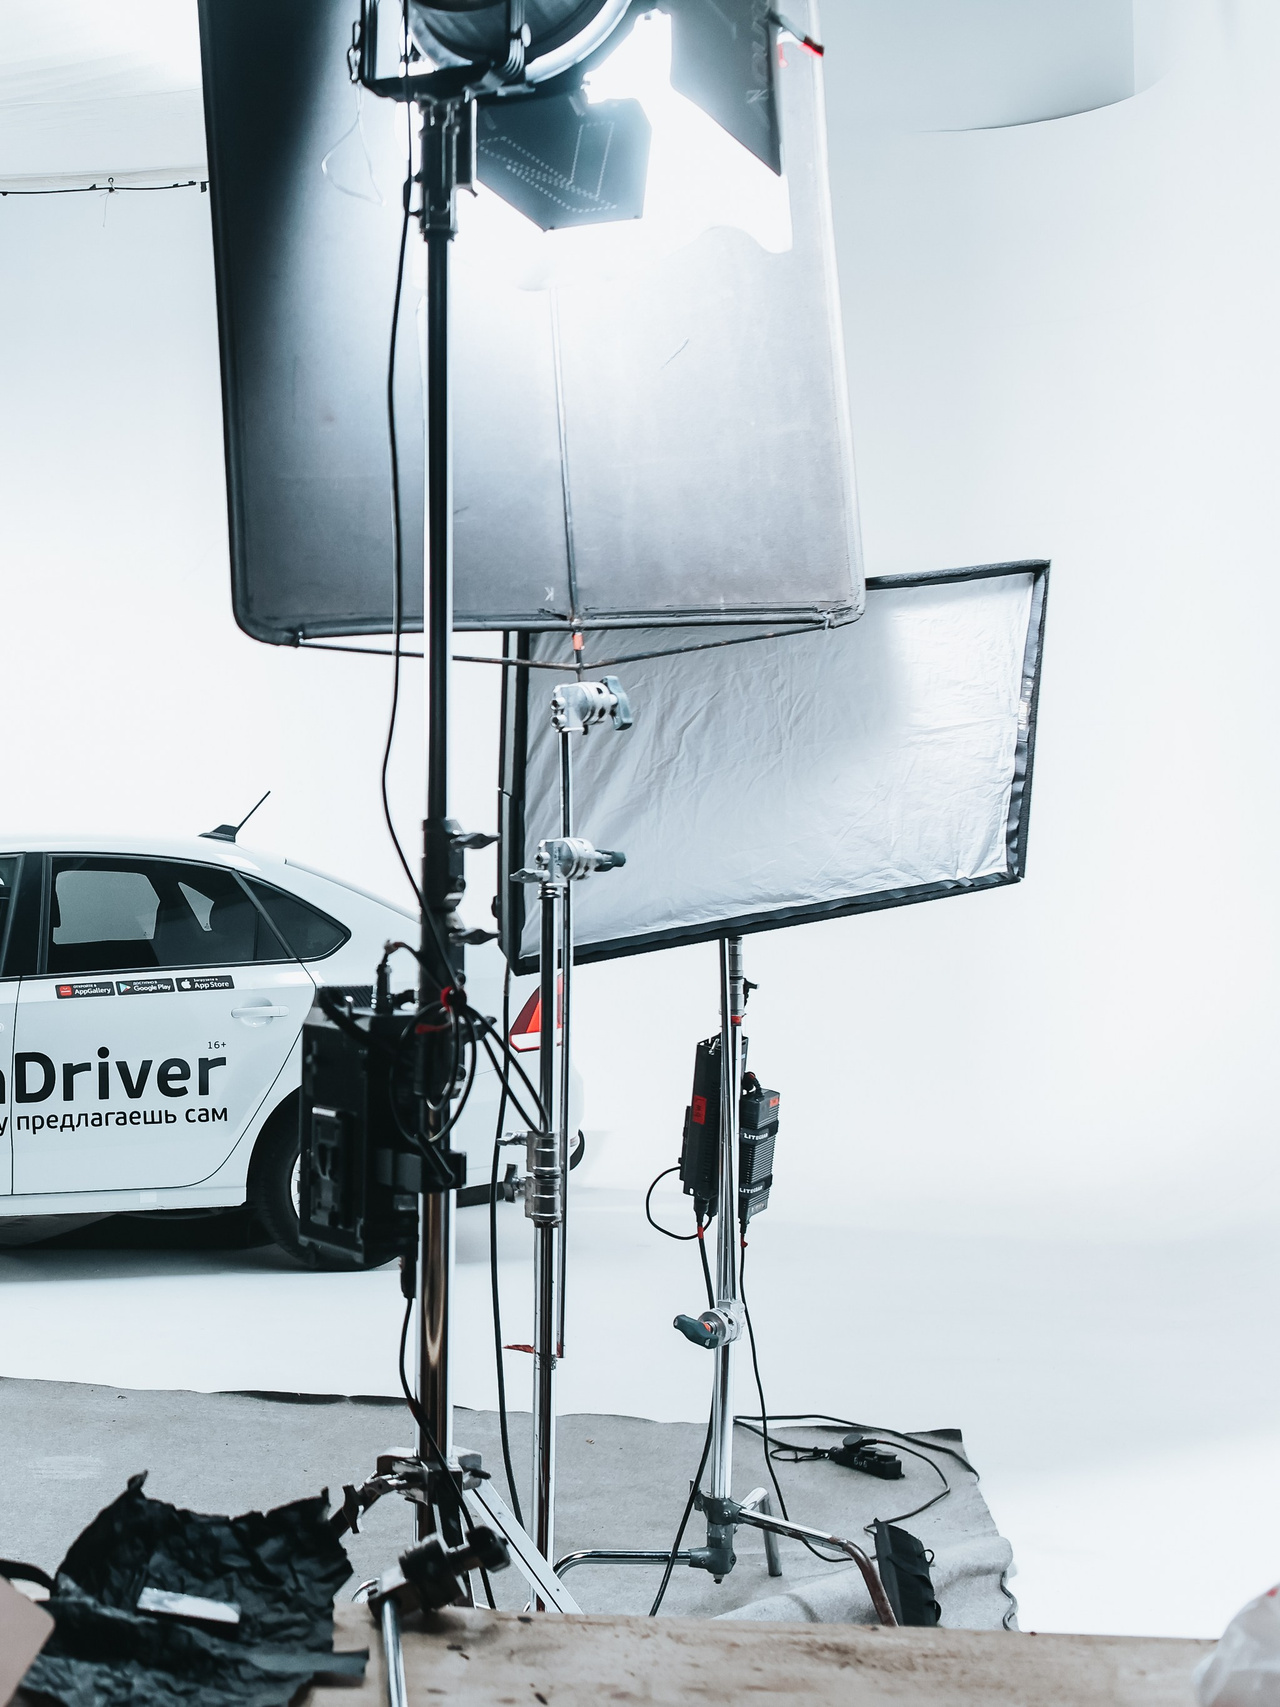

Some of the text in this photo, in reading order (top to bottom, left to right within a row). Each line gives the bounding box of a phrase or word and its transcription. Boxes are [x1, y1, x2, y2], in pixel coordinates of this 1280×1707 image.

[133, 983, 171, 992] Google Play
[194, 982, 210, 990] App
[74, 987, 111, 996] AppGallery
[208, 1040, 227, 1050] 16+
[17, 1110, 177, 1135] предлагаешь
[185, 1107, 228, 1124] сам
